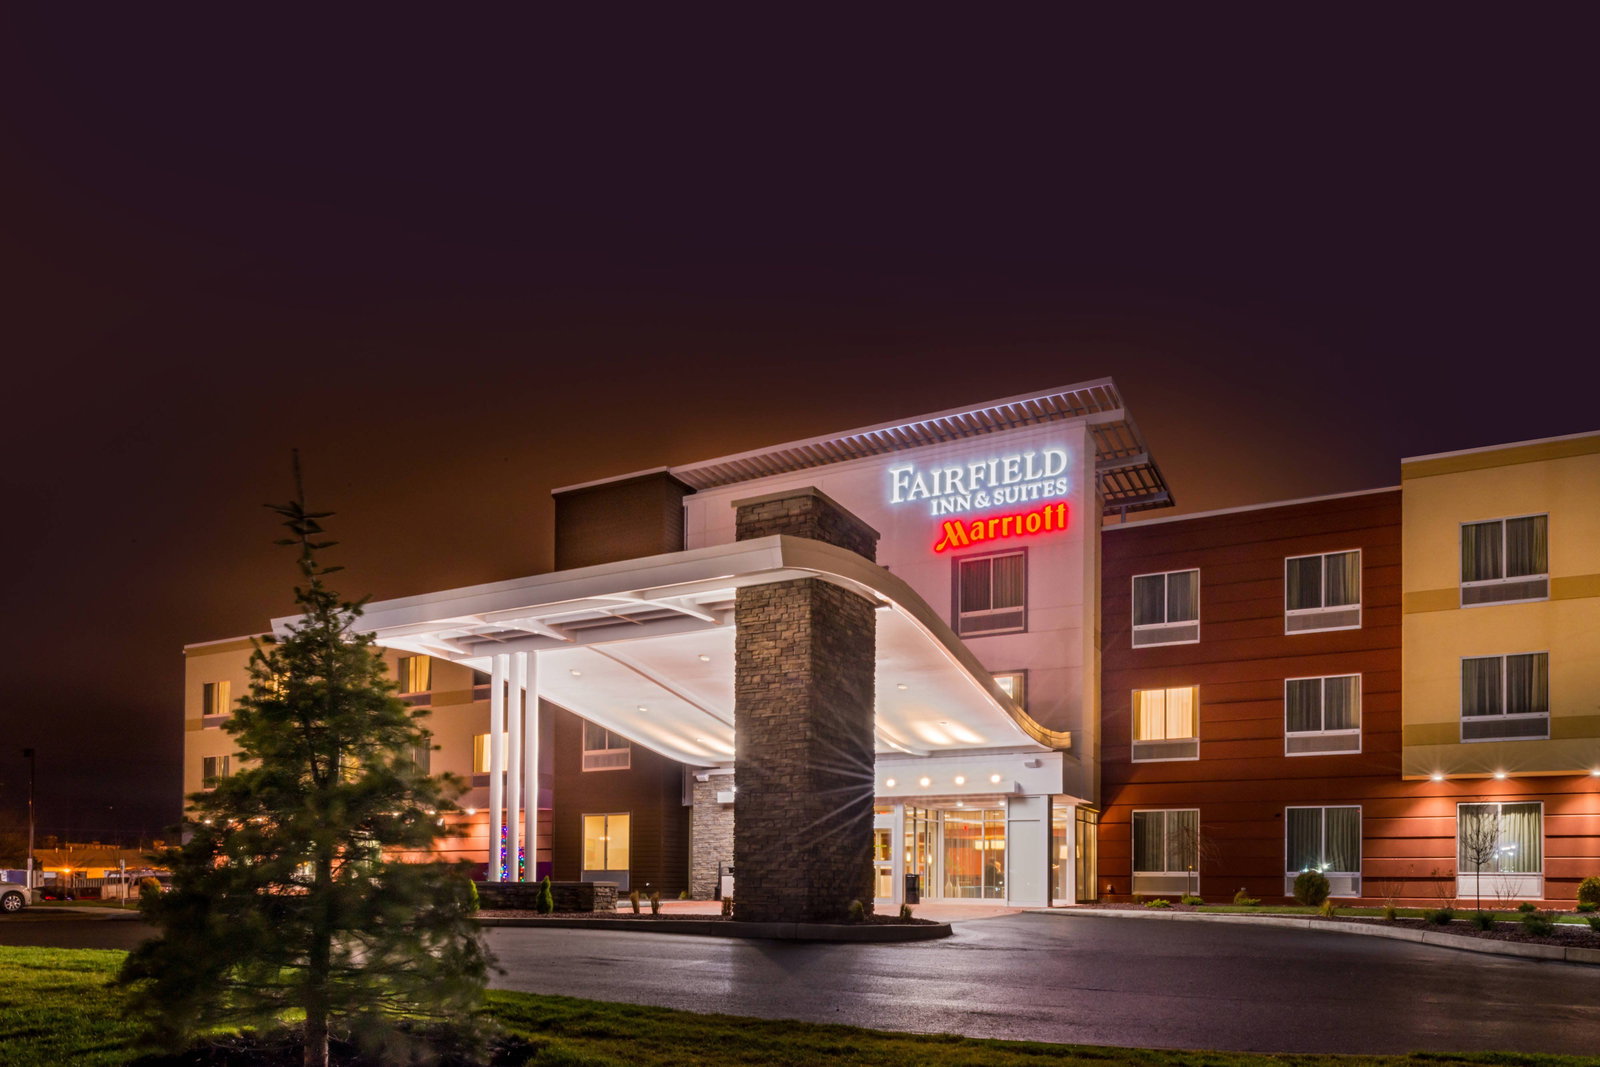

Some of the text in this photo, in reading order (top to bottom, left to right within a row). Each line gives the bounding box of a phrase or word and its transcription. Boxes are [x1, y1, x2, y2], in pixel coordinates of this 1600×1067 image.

[889, 449, 1068, 503] FAIRFIELD
[931, 477, 1067, 516] INN & SUITES
[935, 503, 1068, 551] Marriott
